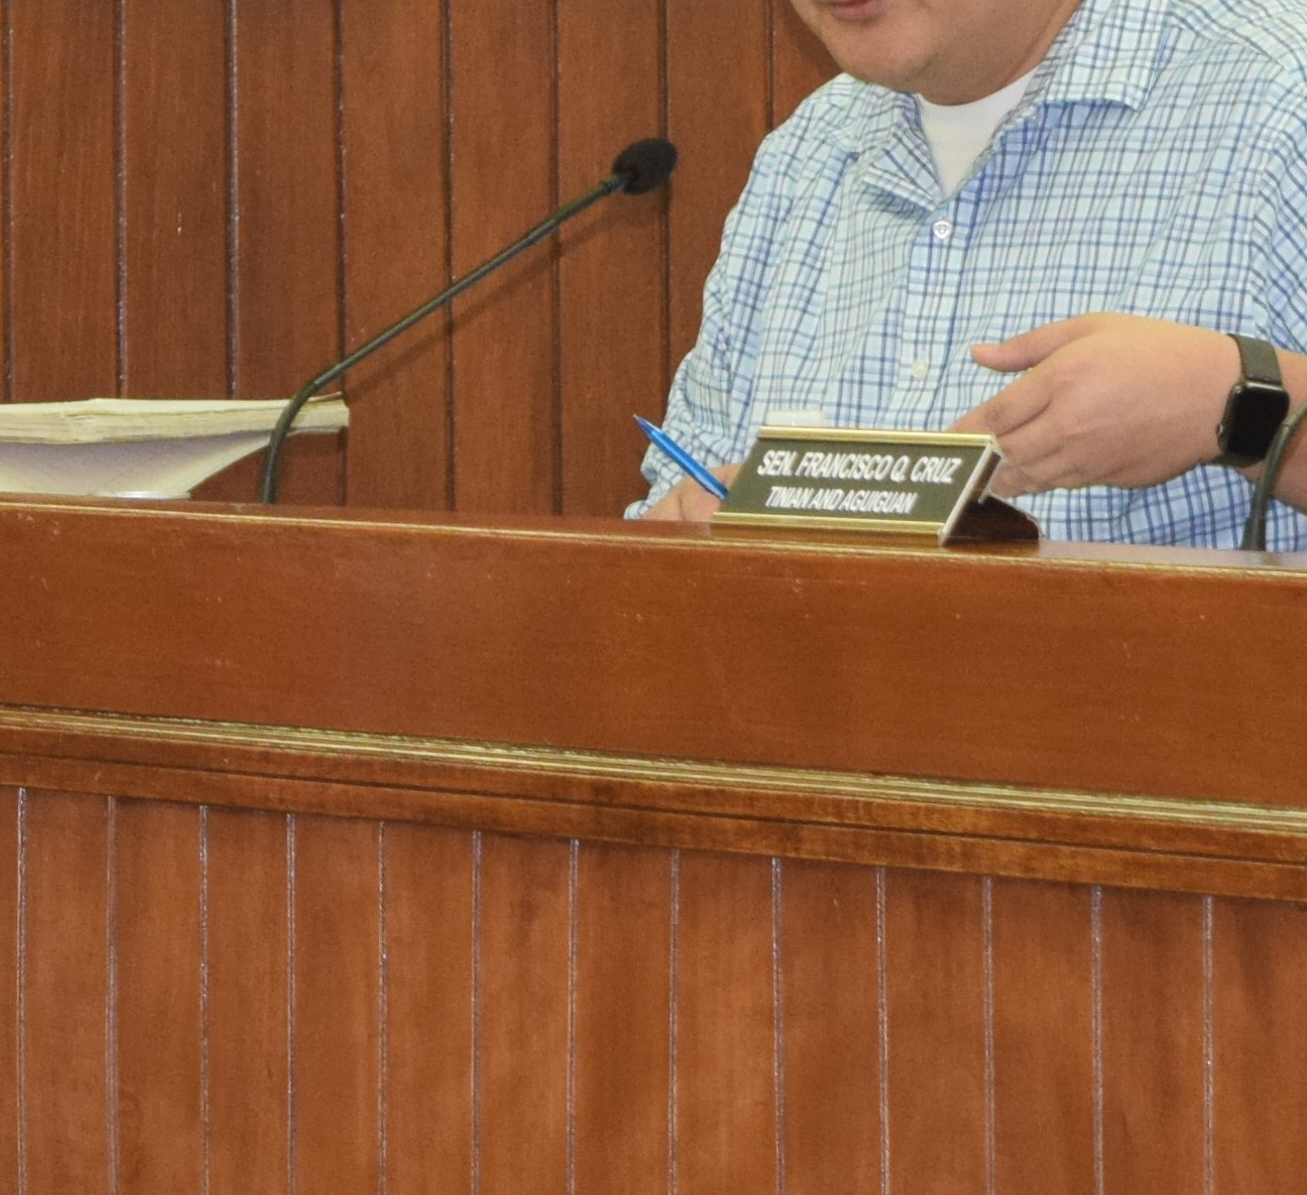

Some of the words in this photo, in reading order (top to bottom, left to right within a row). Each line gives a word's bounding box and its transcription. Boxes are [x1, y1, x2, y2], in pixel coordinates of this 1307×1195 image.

[757, 450, 796, 476] SEN.
[795, 451, 893, 481] FRANCISCO
[890, 456, 911, 483] Q.
[910, 456, 963, 484] CRUZ
[765, 486, 814, 509] TINIAN
[807, 488, 845, 511] AND
[838, 490, 918, 515] AGUIGUAN
